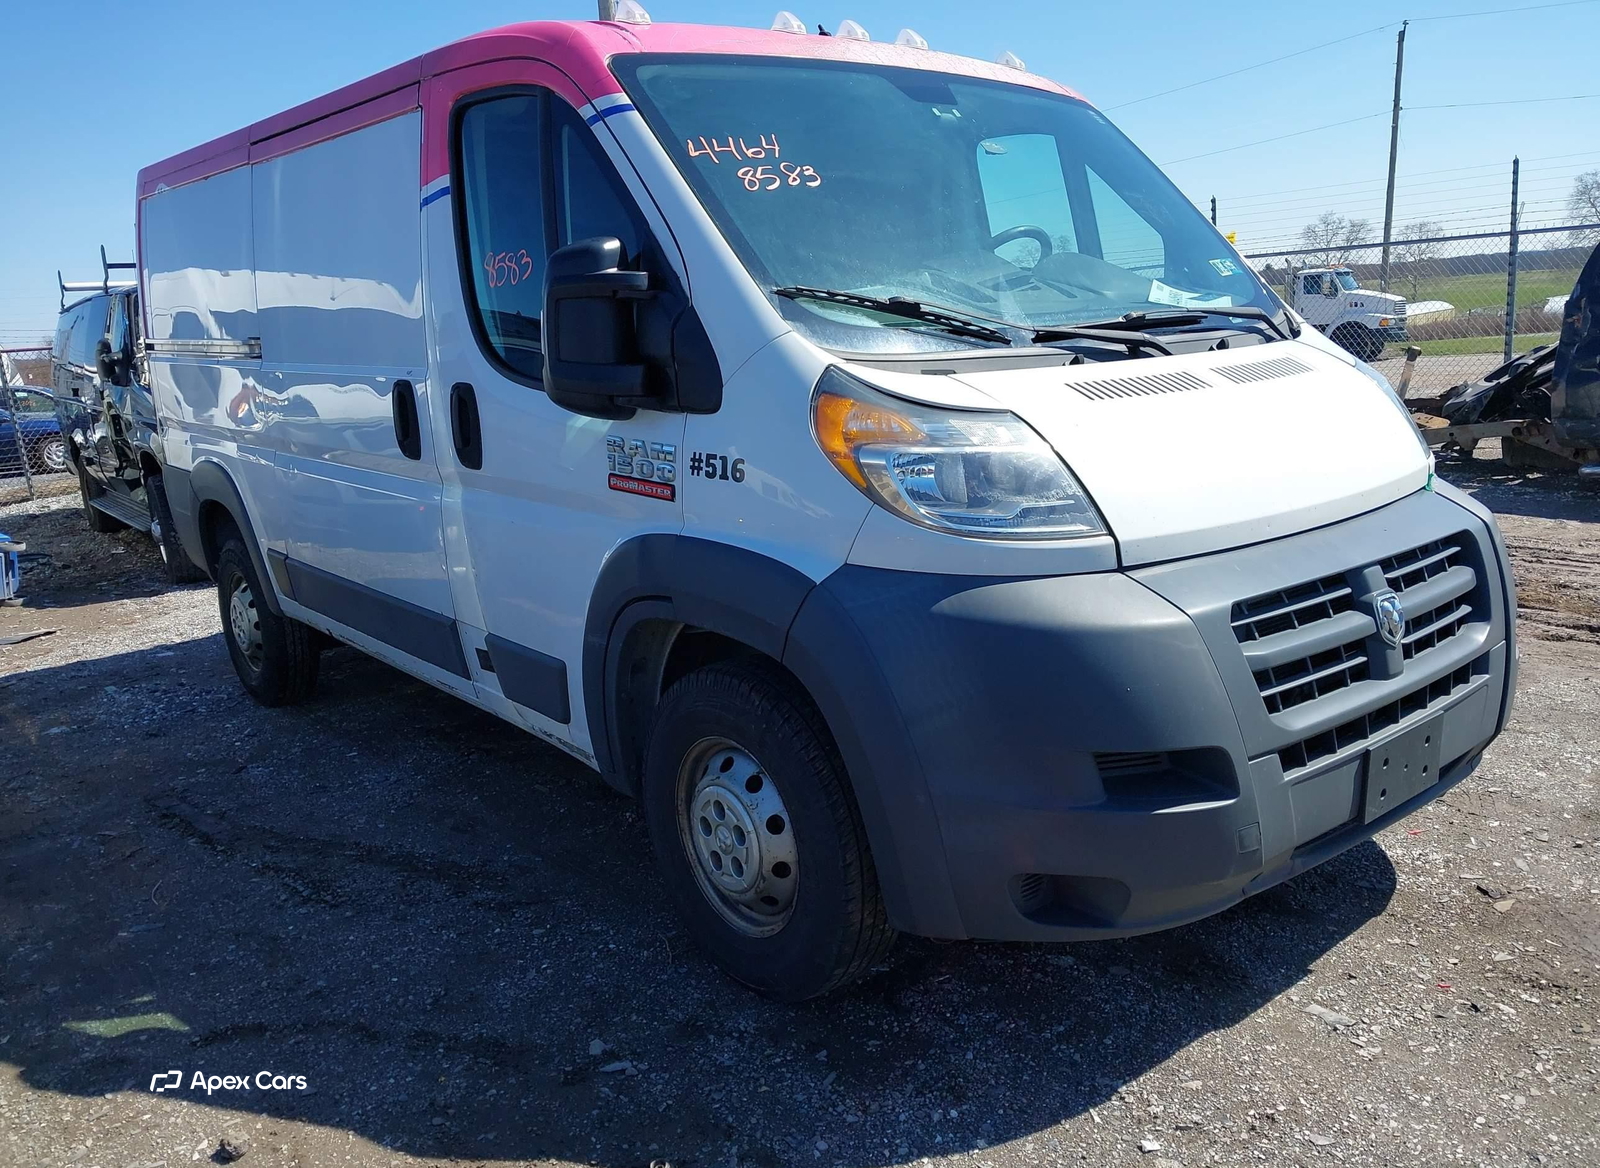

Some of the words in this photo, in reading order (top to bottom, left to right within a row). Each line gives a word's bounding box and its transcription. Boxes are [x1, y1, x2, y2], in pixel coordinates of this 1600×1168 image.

[686, 133, 780, 164] 4464
[737, 162, 822, 191] 8583
[484, 249, 533, 288] 8583
[606, 434, 677, 463] RAM
[607, 453, 677, 482] 1500
[689, 451, 746, 483] #516
